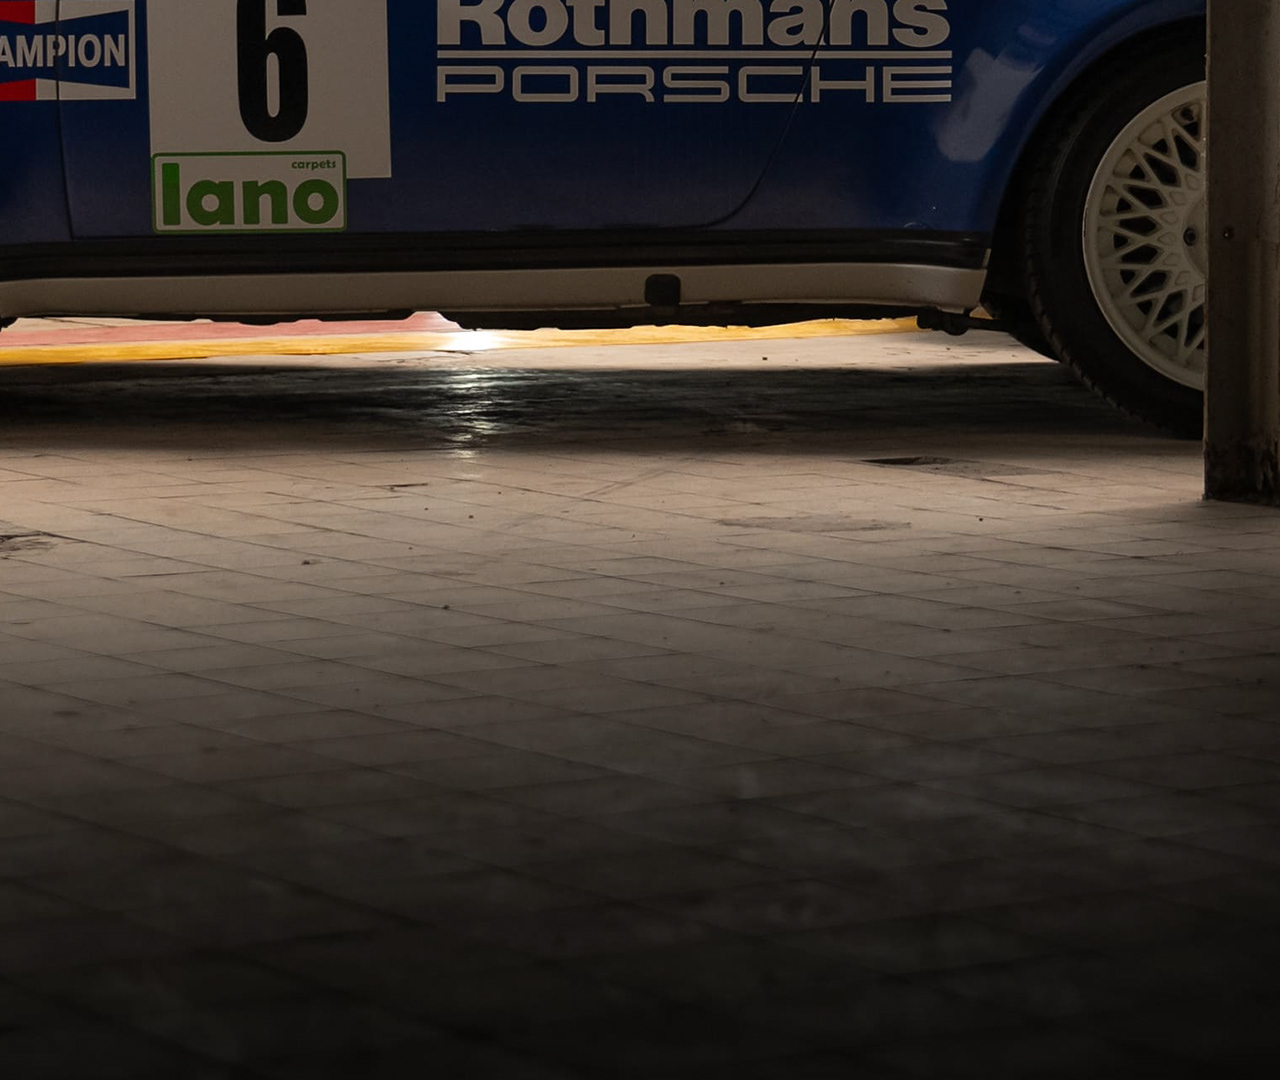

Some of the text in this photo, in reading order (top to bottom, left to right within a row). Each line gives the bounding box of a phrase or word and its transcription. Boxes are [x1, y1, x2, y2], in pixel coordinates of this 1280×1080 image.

[436, 64, 952, 103] PORSCHE
[291, 159, 336, 171] carpets
[161, 162, 339, 226] lano
